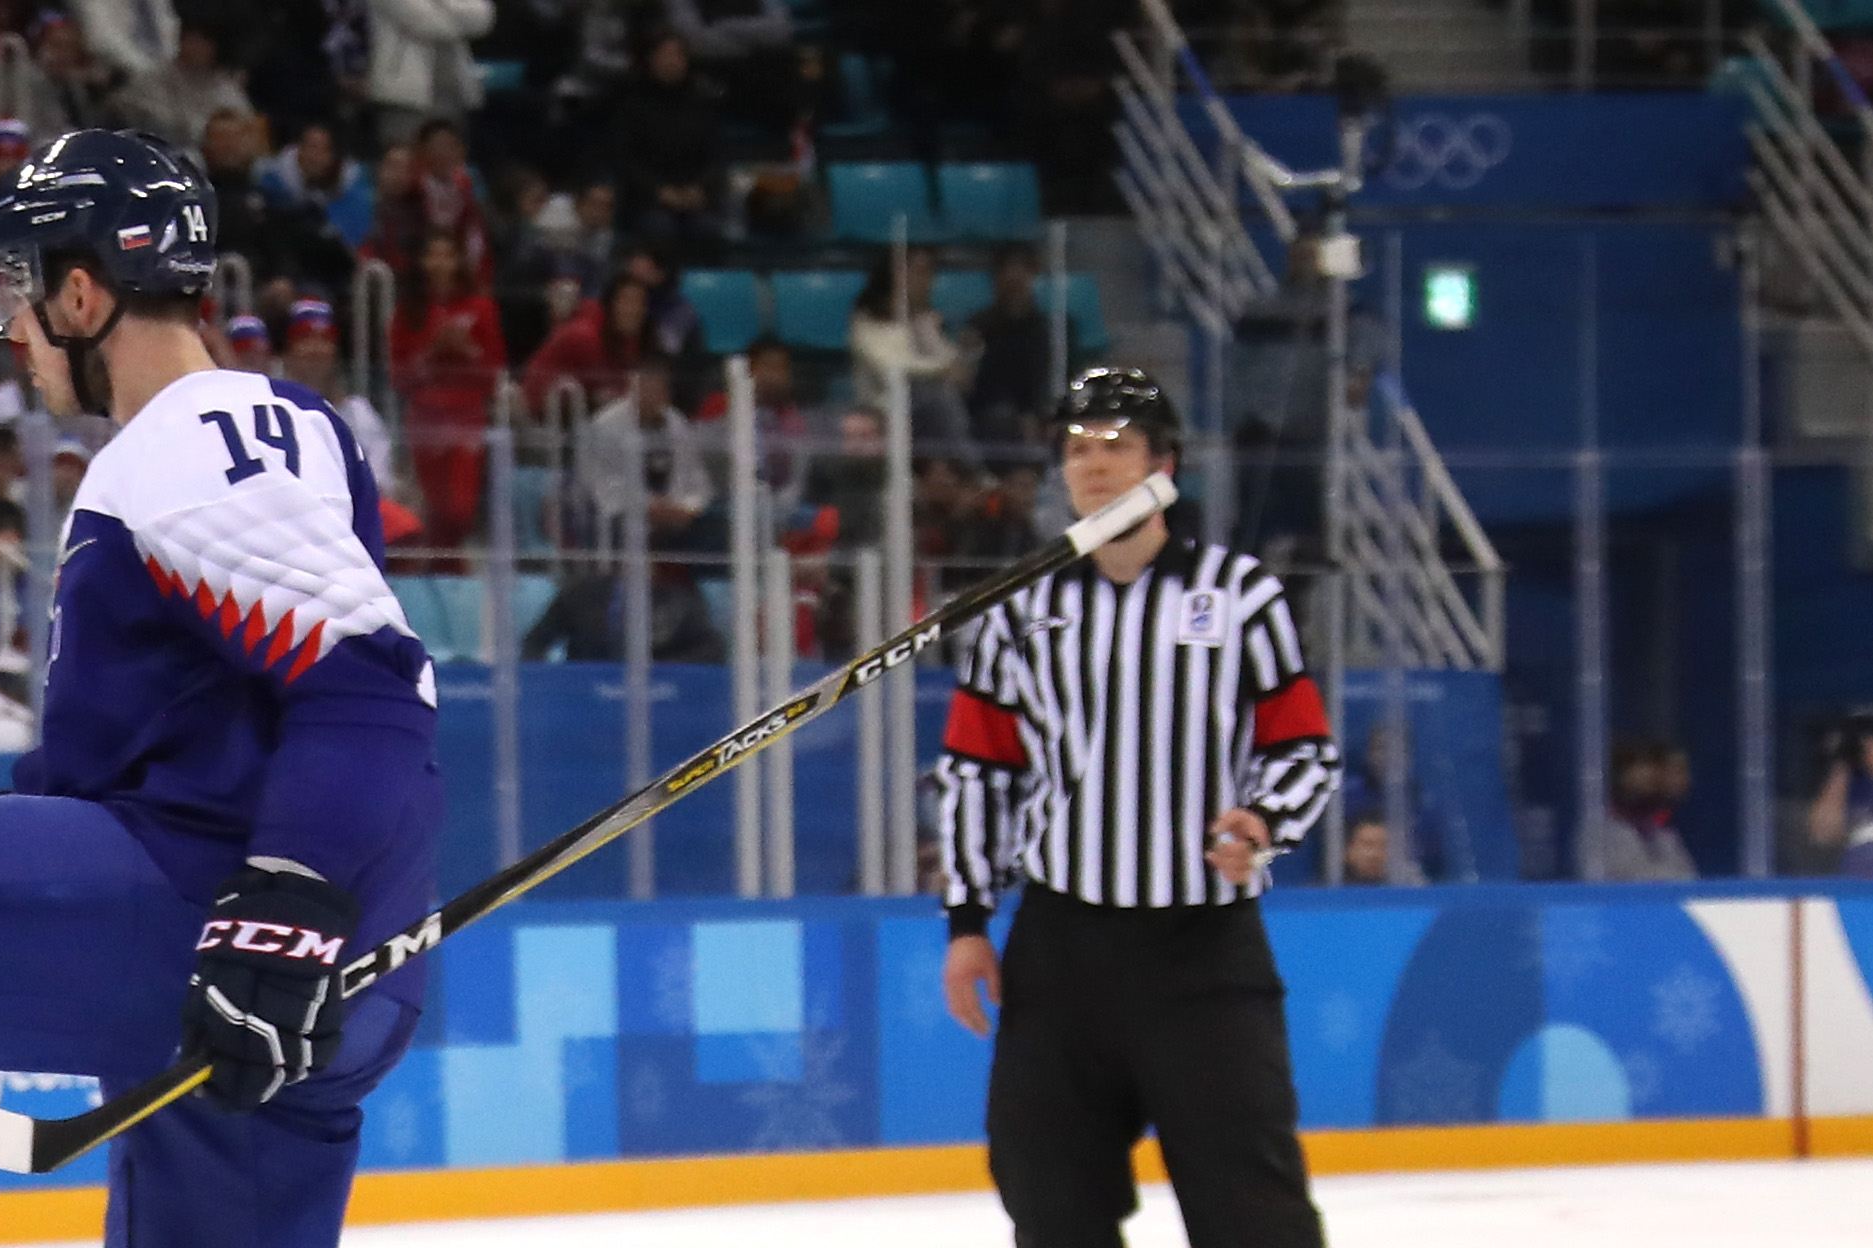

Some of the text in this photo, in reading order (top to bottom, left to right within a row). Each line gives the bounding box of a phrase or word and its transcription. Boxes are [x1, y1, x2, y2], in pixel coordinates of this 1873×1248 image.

[182, 204, 208, 243] 14
[199, 404, 300, 485] 14
[856, 622, 941, 687] CCM
[711, 711, 788, 767] TACKS
[195, 919, 346, 966] CCM
[340, 911, 443, 1000] CM
